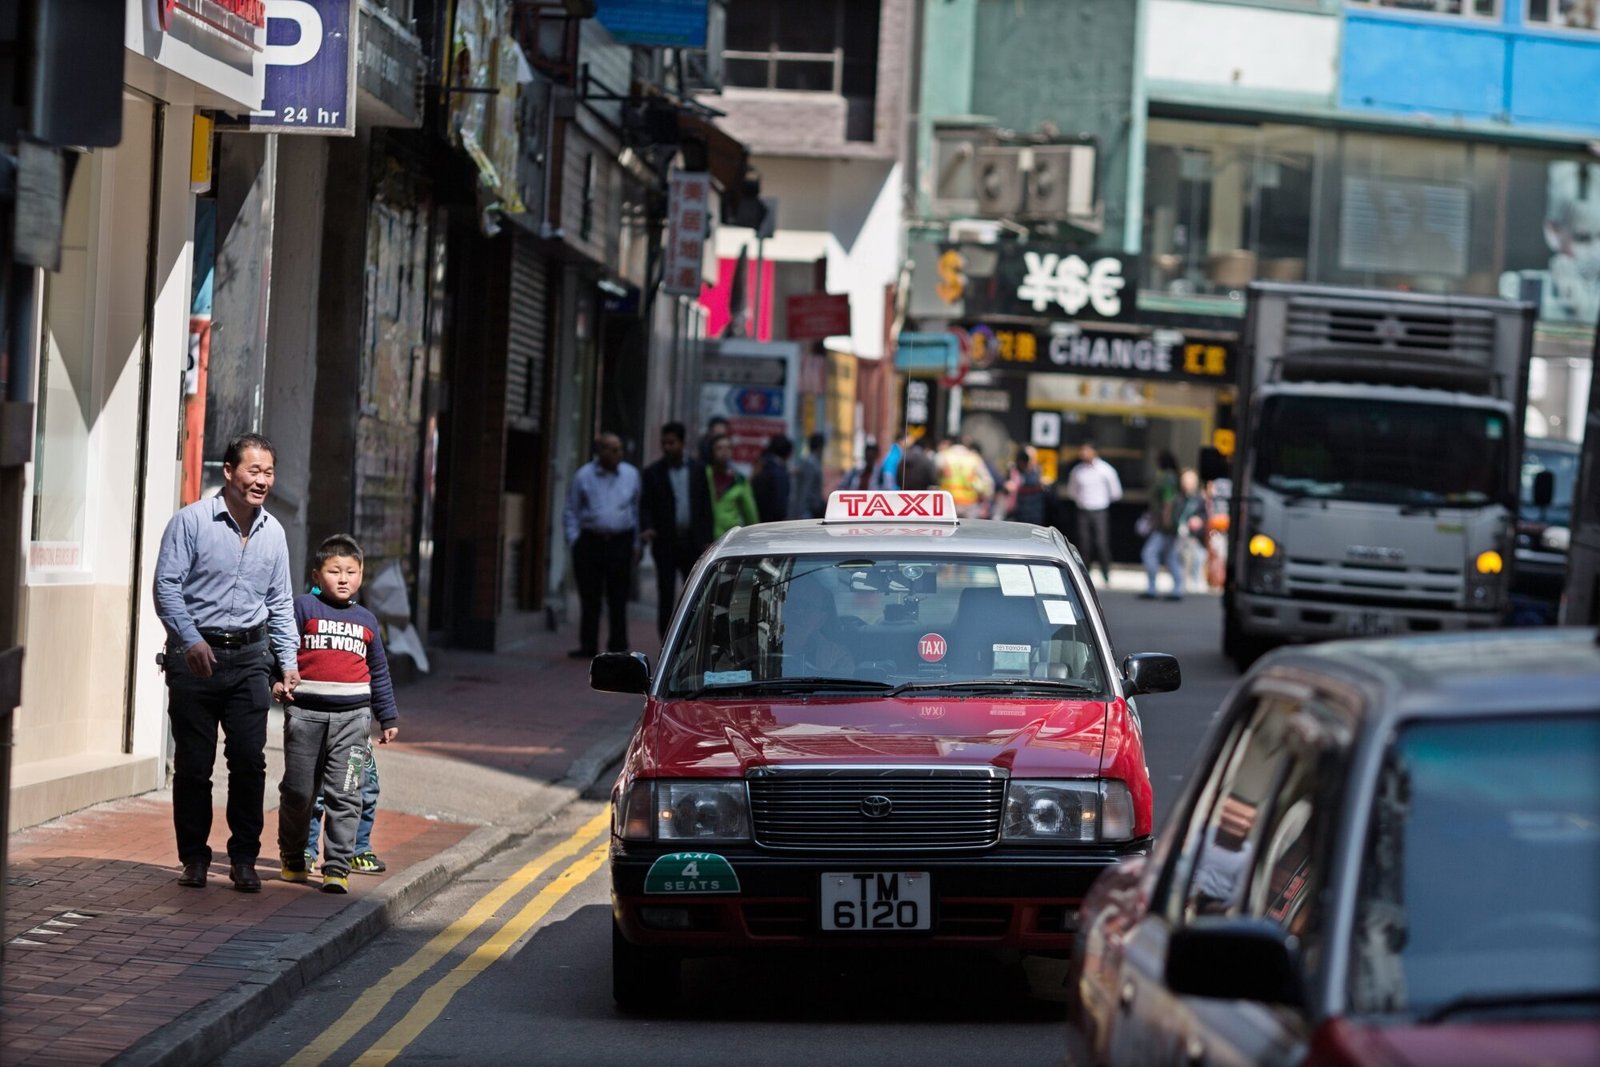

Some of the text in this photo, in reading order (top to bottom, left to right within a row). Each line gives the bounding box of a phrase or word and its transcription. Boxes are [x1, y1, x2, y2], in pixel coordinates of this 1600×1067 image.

[283, 107, 340, 124] 24 hr
[1050, 336, 1173, 373] CHANGE
[839, 493, 944, 517] TAXI
[318, 619, 364, 640] DREAM
[304, 634, 367, 659] THE WORL
[920, 640, 944, 655] TAXI
[672, 852, 711, 861] TAXI
[681, 861, 700, 879] 4
[664, 880, 720, 892] SEATS
[853, 873, 899, 901] TM
[833, 900, 918, 929] 6120
